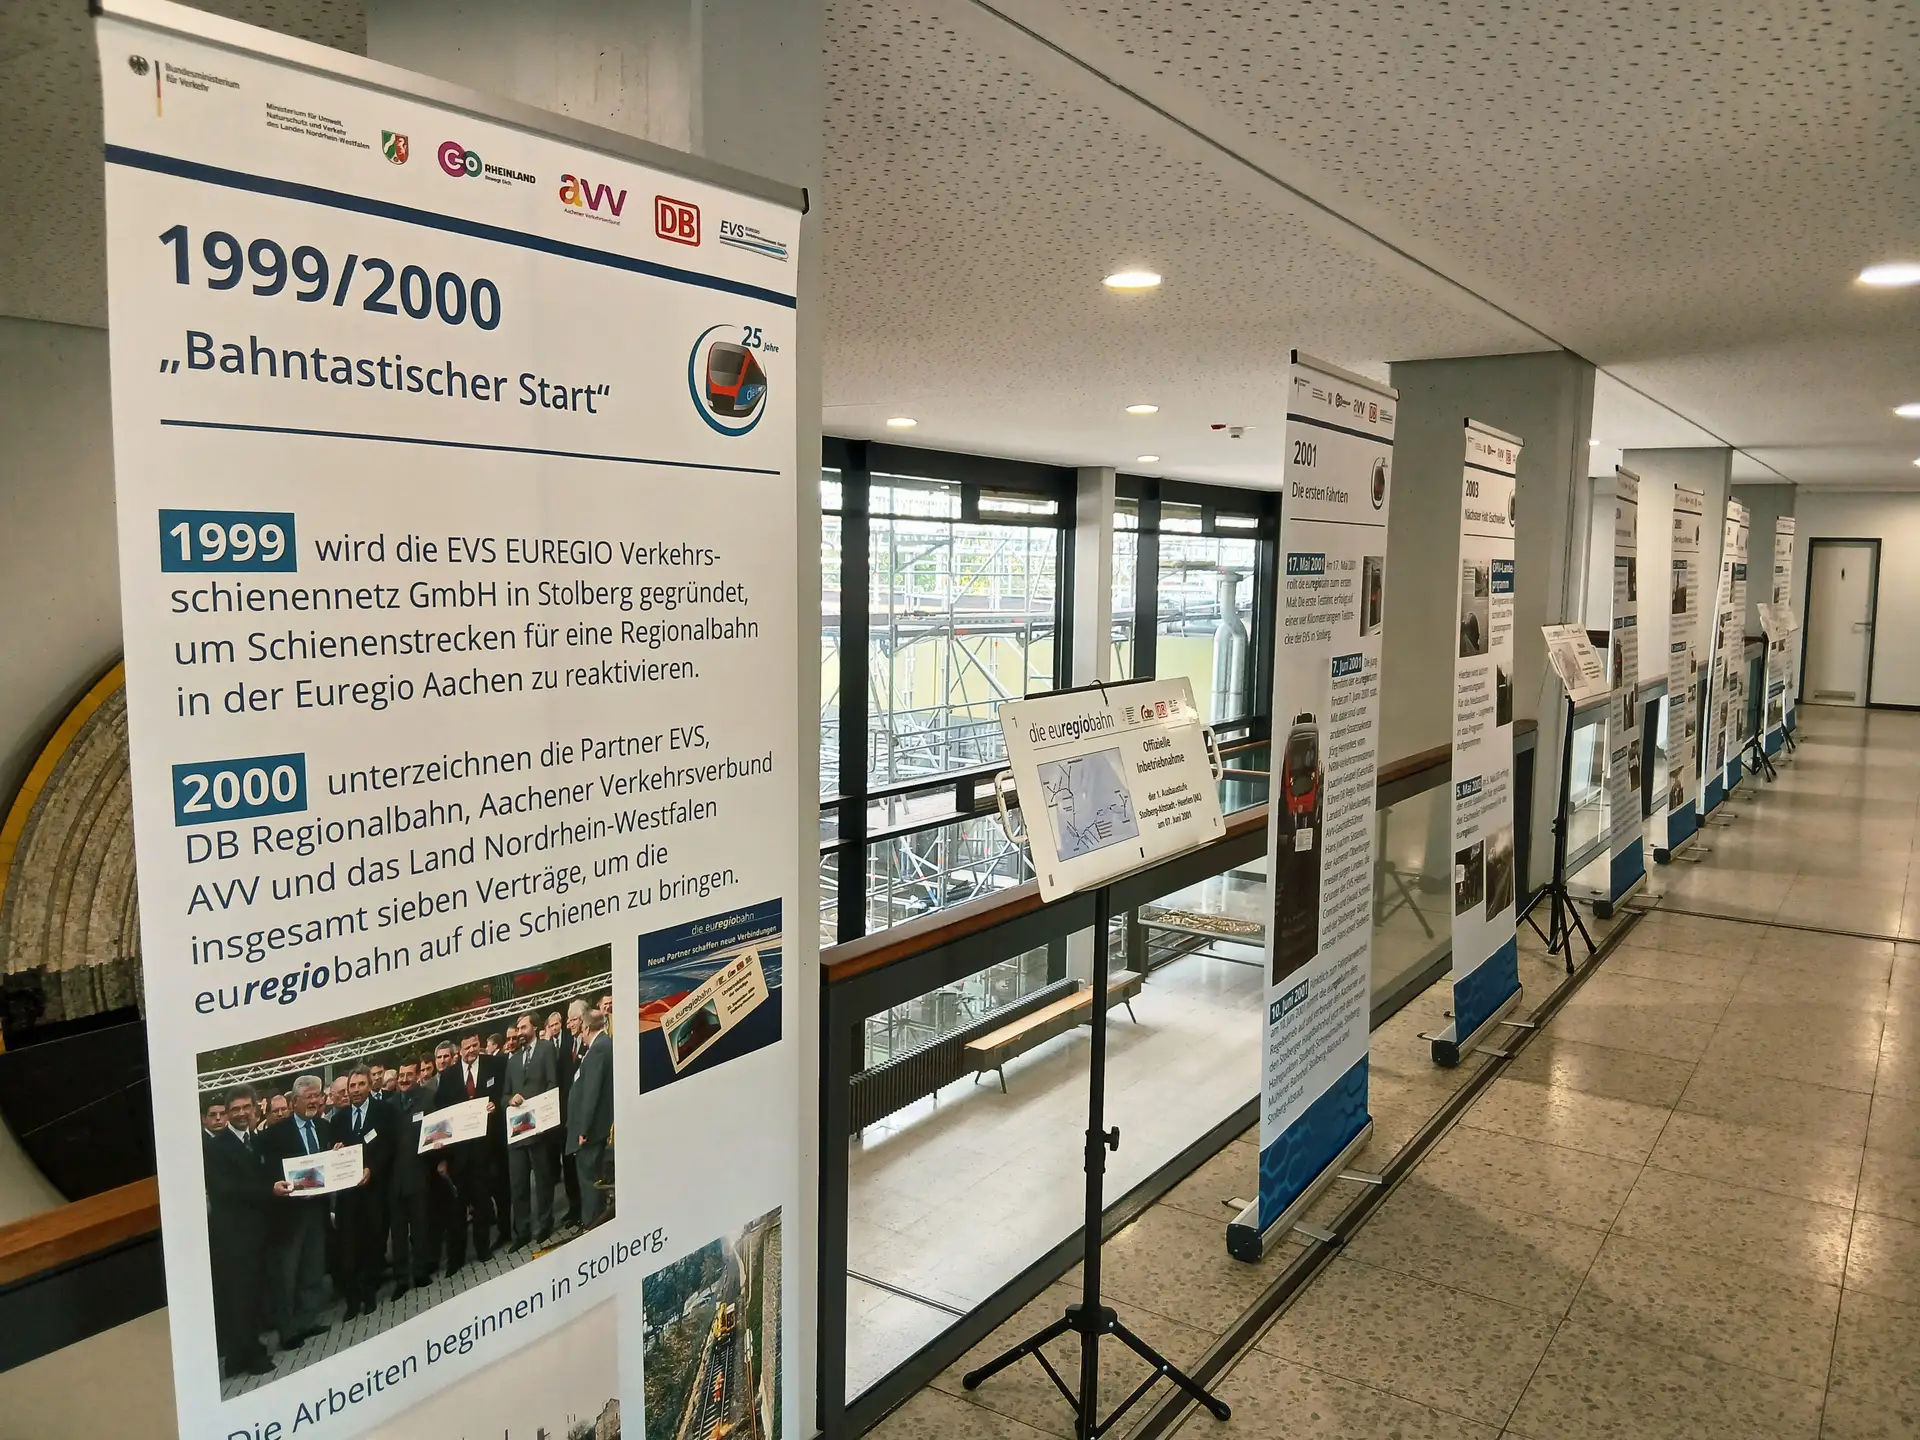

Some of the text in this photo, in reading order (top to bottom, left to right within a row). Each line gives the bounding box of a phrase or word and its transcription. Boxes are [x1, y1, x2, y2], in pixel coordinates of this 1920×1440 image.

[165, 62, 241, 89] Bundesministerium
[166, 74, 210, 93] für Verkehr
[266, 103, 343, 127] Ministerium für Umwelt,
[266, 112, 347, 136] Naturschutz und Verkehr
[266, 120, 370, 150] des Landes Nordrhein-Westfalen
[484, 163, 536, 184] RHEINLAND
[559, 174, 628, 217] avv
[658, 201, 697, 241] DB
[720, 220, 744, 238] EVS
[158, 224, 502, 331] 1999/2000
[741, 325, 780, 353] 25 Jahre
[159, 330, 610, 414] „Bahntastischer Start“
[1294, 440, 1317, 468] 2001
[1292, 482, 1348, 504] Die ersten Fahrten
[1466, 480, 1480, 498] 2003
[169, 522, 720, 566] 1999 wird die EVS EUREGIO Verkehrs-
[1288, 556, 1324, 572] 17. Mai 2001
[171, 580, 748, 614] schienennetz GmbH in Stolberg gegründet,
[175, 616, 760, 666] um Schienenstrecken für eine Regionalbahn
[1332, 656, 1362, 676] 7. Juni 2001
[177, 658, 700, 717] in der Euregio Aachen zu reaktivieren.
[1029, 722, 1046, 743] die
[1048, 712, 1115, 740] euregiobahn
[1143, 736, 1172, 753] Offizielle
[182, 724, 710, 814] 2000 unterzeichnen die Partner EVS,
[1136, 752, 1185, 774] Inbetriebnahme
[1156, 790, 1160, 800] 1.
[1161, 783, 1188, 799] Ausbaustufe
[186, 751, 772, 864] DB Regionalbahn, Aachener Verkehrsverbund
[1157, 821, 1164, 830] am
[1172, 814, 1182, 827] Juni
[1182, 811, 1192, 822] 2001
[187, 800, 718, 916] AVV und das Land Nordrhein-Westfalen
[191, 842, 669, 965] insgesamt sieben Verträge, um die
[692, 912, 755, 936] die euregiobahn
[195, 868, 740, 1015] euregiobahn auf die Schienen zu bringen.
[647, 926, 777, 967] Neue Partner schaffen neue Verbindungen
[676, 987, 712, 1020] euregiobahn
[1271, 982, 1308, 1021] 10. Juni 2001
[293, 1354, 418, 1432] Arbeiten
[426, 1290, 544, 1364] beginnen
[550, 1276, 572, 1308] in
[576, 1224, 670, 1286] Stolberg.
